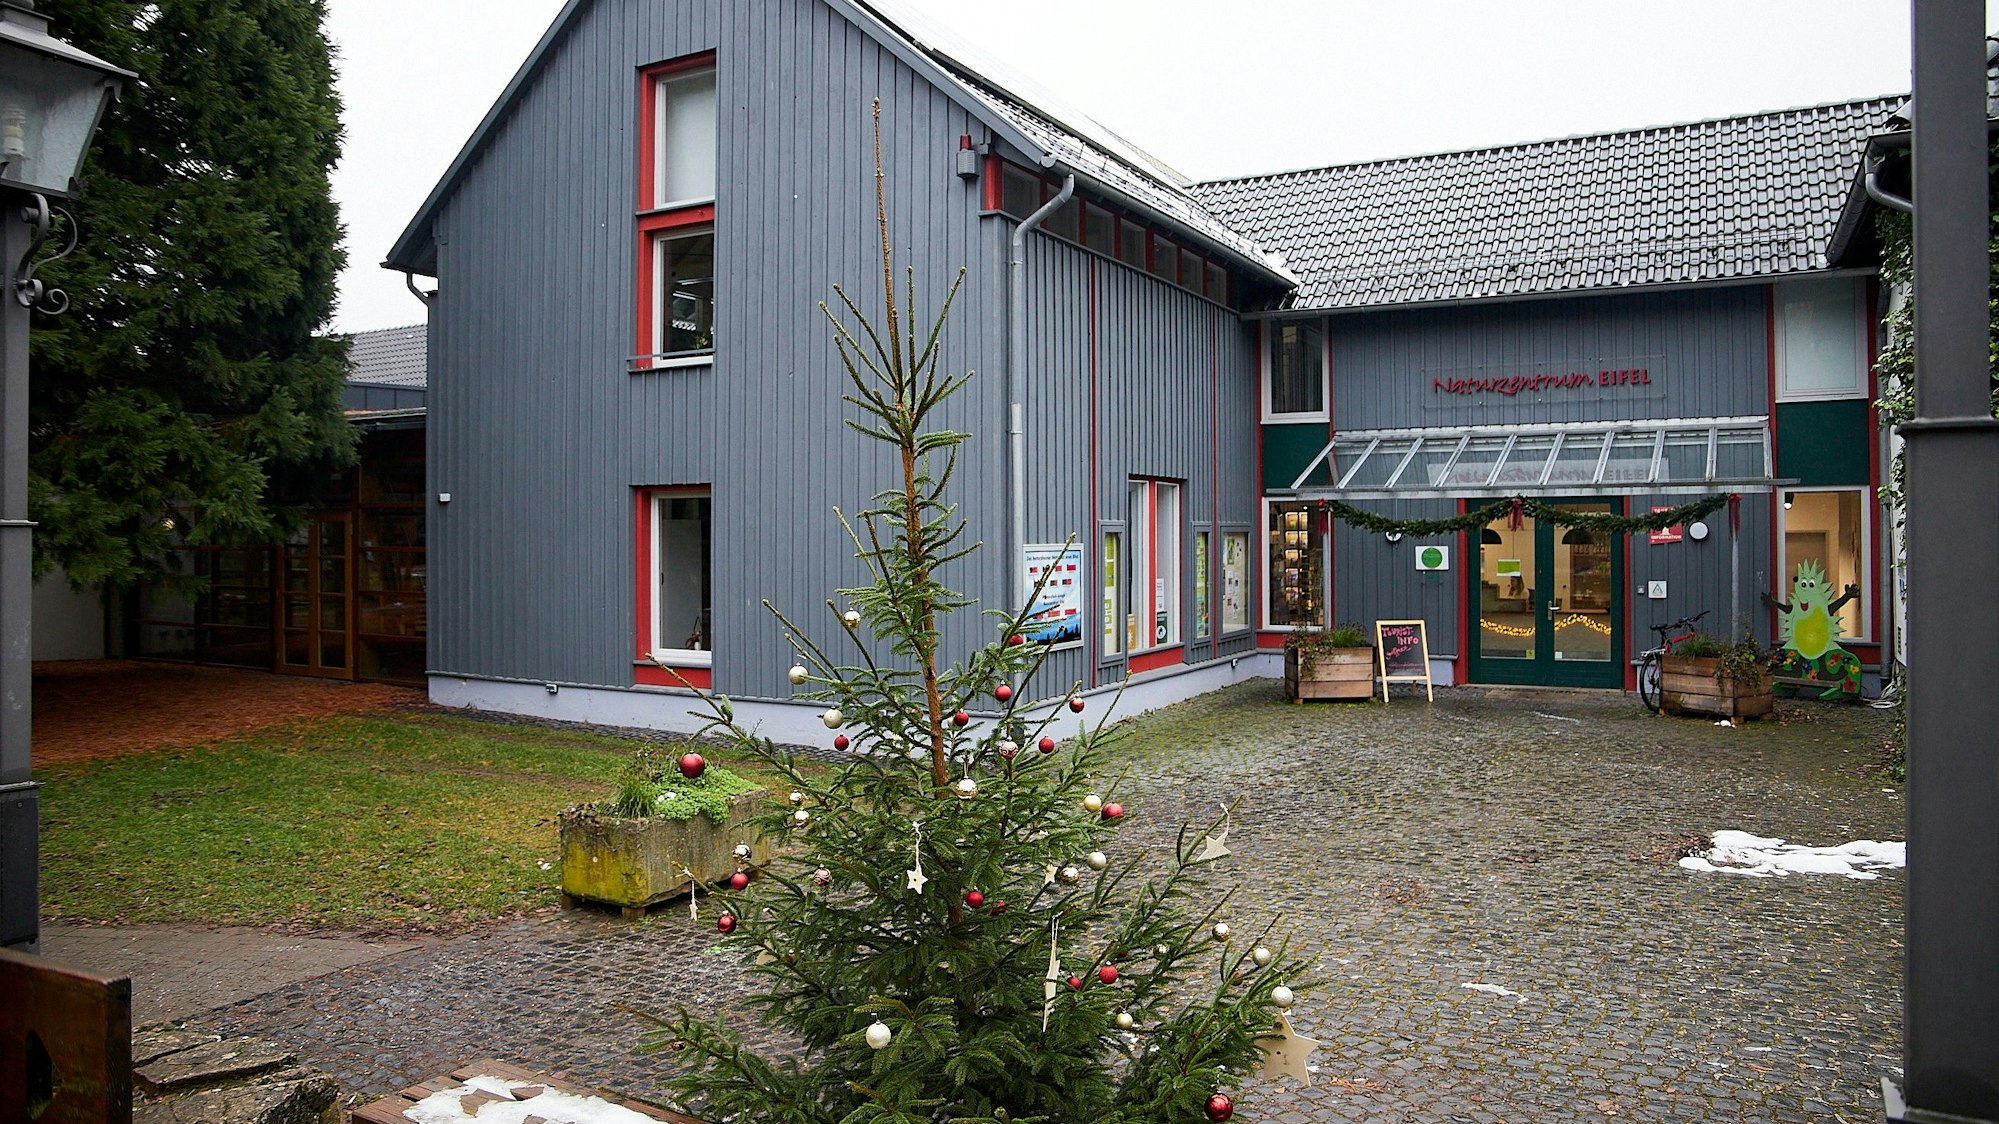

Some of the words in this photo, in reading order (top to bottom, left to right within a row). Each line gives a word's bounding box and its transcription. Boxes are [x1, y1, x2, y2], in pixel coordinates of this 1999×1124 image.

[1433, 372, 1593, 395] Naturzentrum
[1599, 368, 1652, 386] EIFEL
[1397, 636, 1419, 645] INFO
